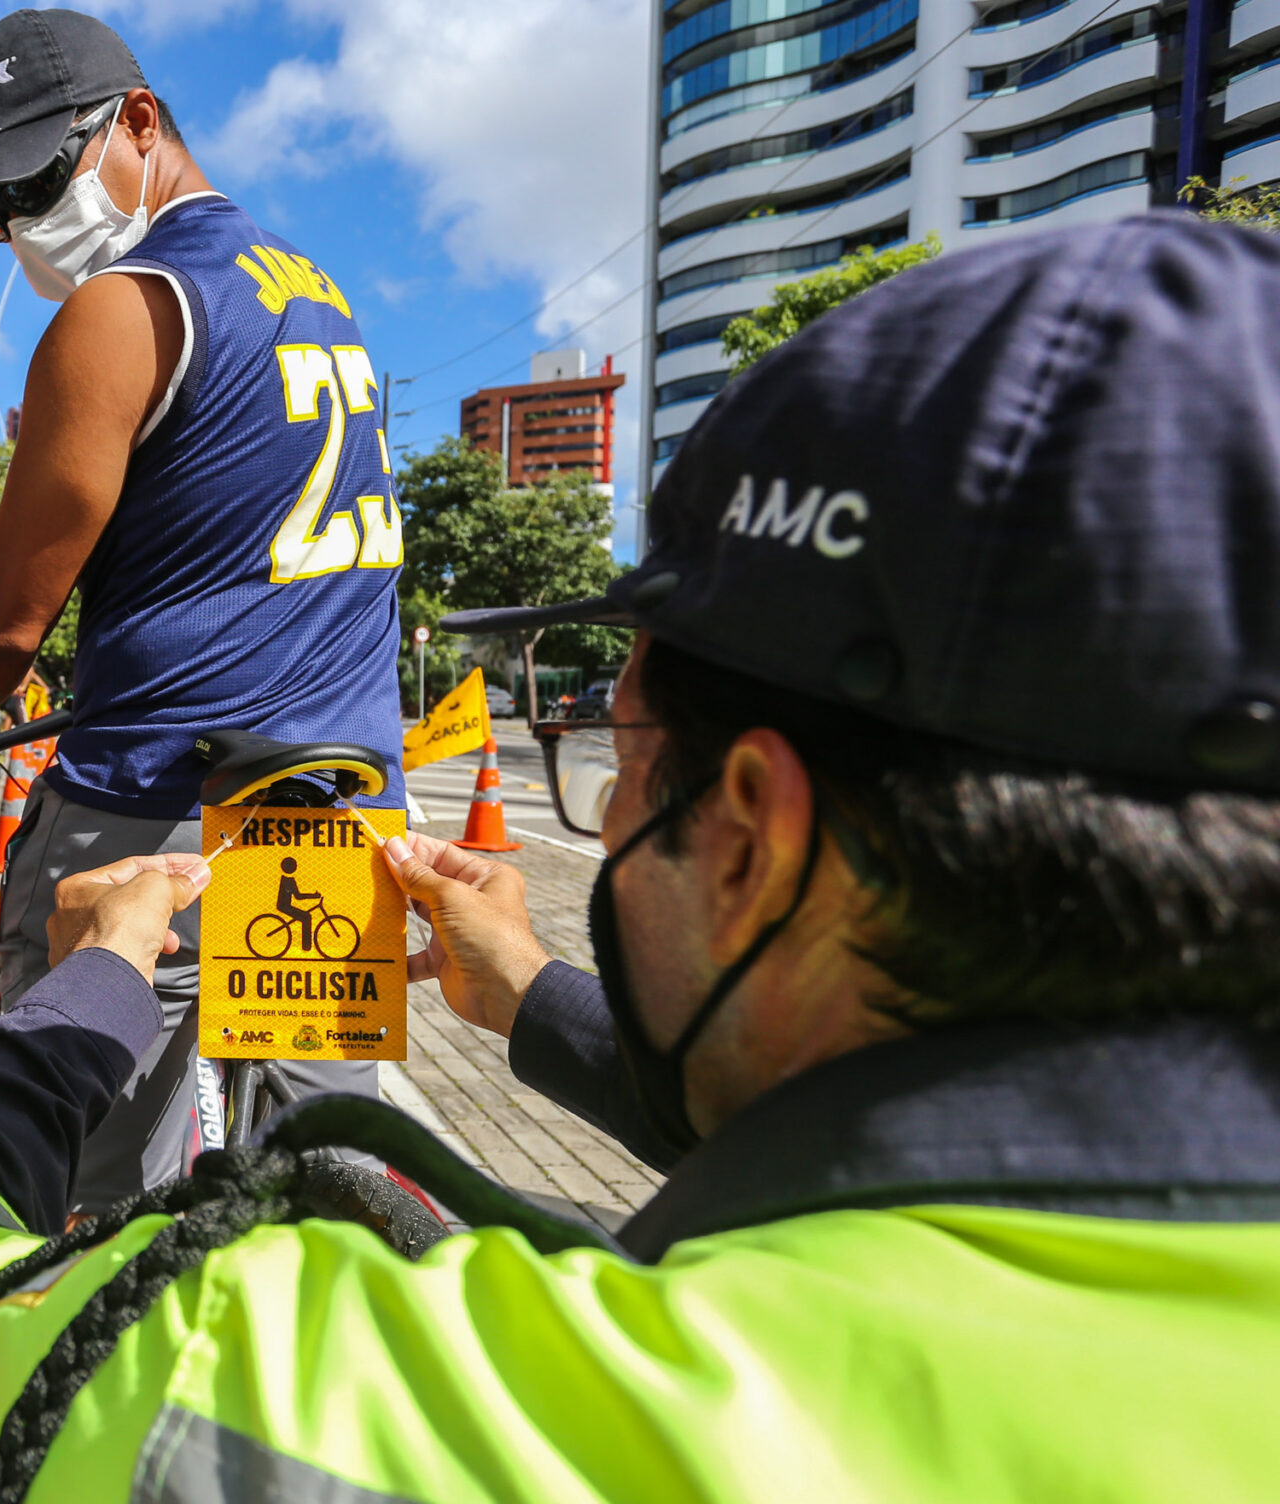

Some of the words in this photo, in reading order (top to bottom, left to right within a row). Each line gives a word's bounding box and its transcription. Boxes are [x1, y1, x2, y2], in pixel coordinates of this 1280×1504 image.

[269, 343, 404, 585] 23
[718, 474, 870, 560] AMC
[242, 818, 365, 848] RESPEITE
[229, 970, 245, 998] O
[257, 970, 378, 1001] CICLISTA
[239, 1009, 276, 1017] PROTEGER
[240, 1030, 274, 1043] AMC
[326, 1030, 383, 1041] Fortaleza
